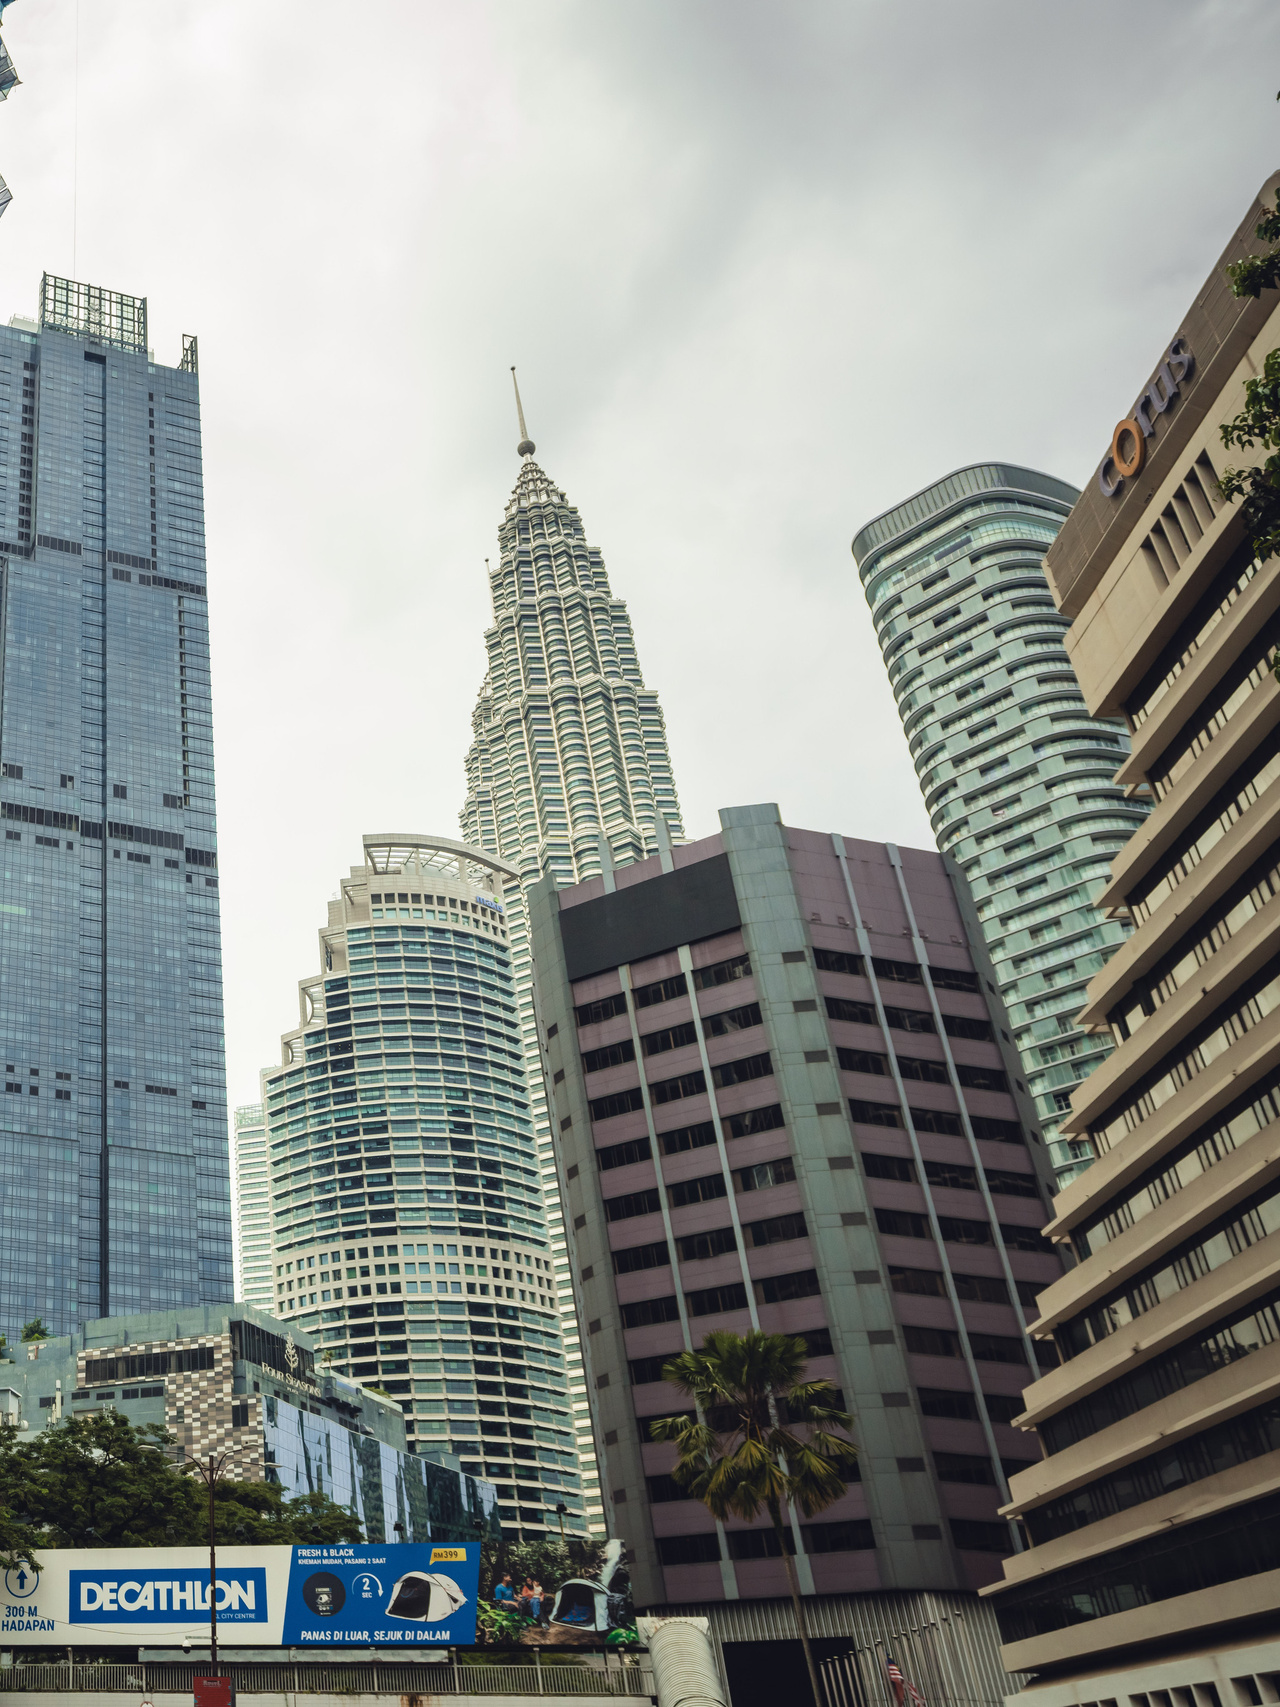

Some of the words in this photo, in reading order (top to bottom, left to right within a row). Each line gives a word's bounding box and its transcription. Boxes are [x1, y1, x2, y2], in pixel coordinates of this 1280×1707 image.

[476, 896, 503, 913] maxis
[286, 1373, 321, 1397] SEASONS
[297, 1549, 321, 1557] FRESH
[322, 1549, 328, 1557] &
[329, 1548, 354, 1557] BLACK
[322, 1558, 344, 1566] MUDAH,
[362, 1578, 370, 1590] 2
[80, 1580, 256, 1612] DECATHLON
[5, 1605, 25, 1617] 300
[27, 1605, 38, 1617] M
[1, 1620, 55, 1632] HADAPAN
[300, 1630, 332, 1641] PANAS
[333, 1630, 343, 1641] DI
[344, 1630, 371, 1643] LUAR,
[373, 1630, 403, 1641] SEJUK
[404, 1630, 415, 1641] DI
[416, 1630, 450, 1641] DALAM
